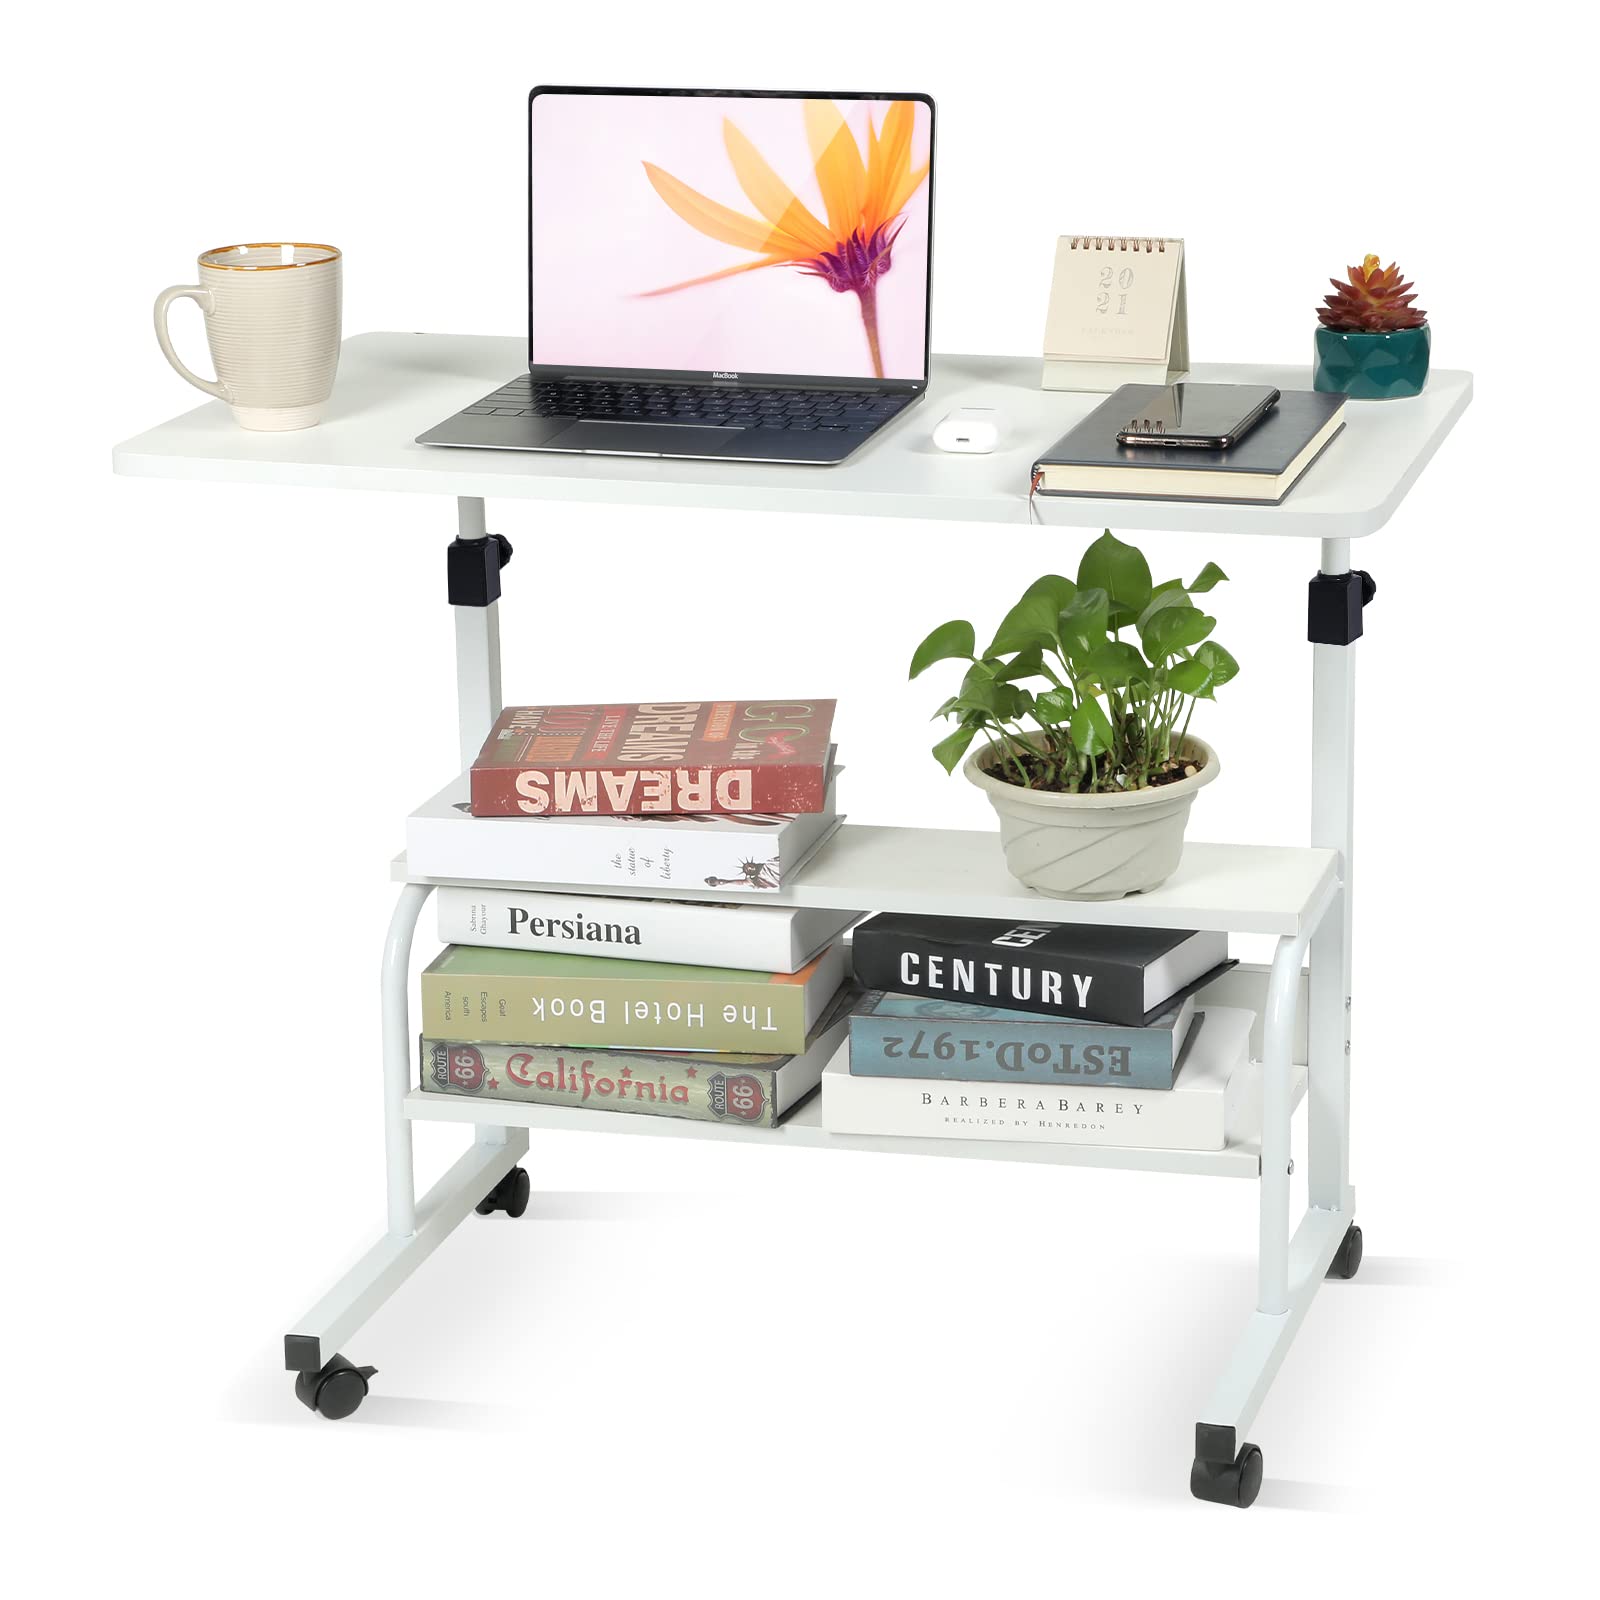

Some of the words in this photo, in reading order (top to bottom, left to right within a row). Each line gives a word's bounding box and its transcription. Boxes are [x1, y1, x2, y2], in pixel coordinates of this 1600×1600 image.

[1098, 266, 1134, 290] 20
[1096, 292, 1129, 315] 21
[712, 371, 739, 380] MacBook
[617, 703, 701, 762] DREAMS
[514, 769, 753, 813] DREAMS
[610, 853, 623, 869] the
[627, 847, 637, 876] statue
[639, 857, 654, 869] of
[659, 847, 674, 880] liberty
[507, 906, 642, 946] Persiana
[900, 951, 1093, 1009] CENTURY
[443, 991, 452, 1021] America
[480, 991, 488, 1023] Escapes
[532, 996, 606, 1024] Book
[624, 1001, 704, 1028] Hotel
[723, 1003, 778, 1031] The
[436, 1050, 448, 1080] ROUTE
[454, 1055, 475, 1080] 66
[505, 1052, 689, 1105] California
[713, 1080, 725, 1110] ROUTE
[732, 1085, 754, 1109] 66
[921, 1092, 1046, 1111] BARBERA
[1058, 1098, 1144, 1115] BAREY
[944, 1116, 1006, 1126] REALIZED
[1014, 1119, 1029, 1127] BY
[1039, 1120, 1106, 1130] HENREDON
